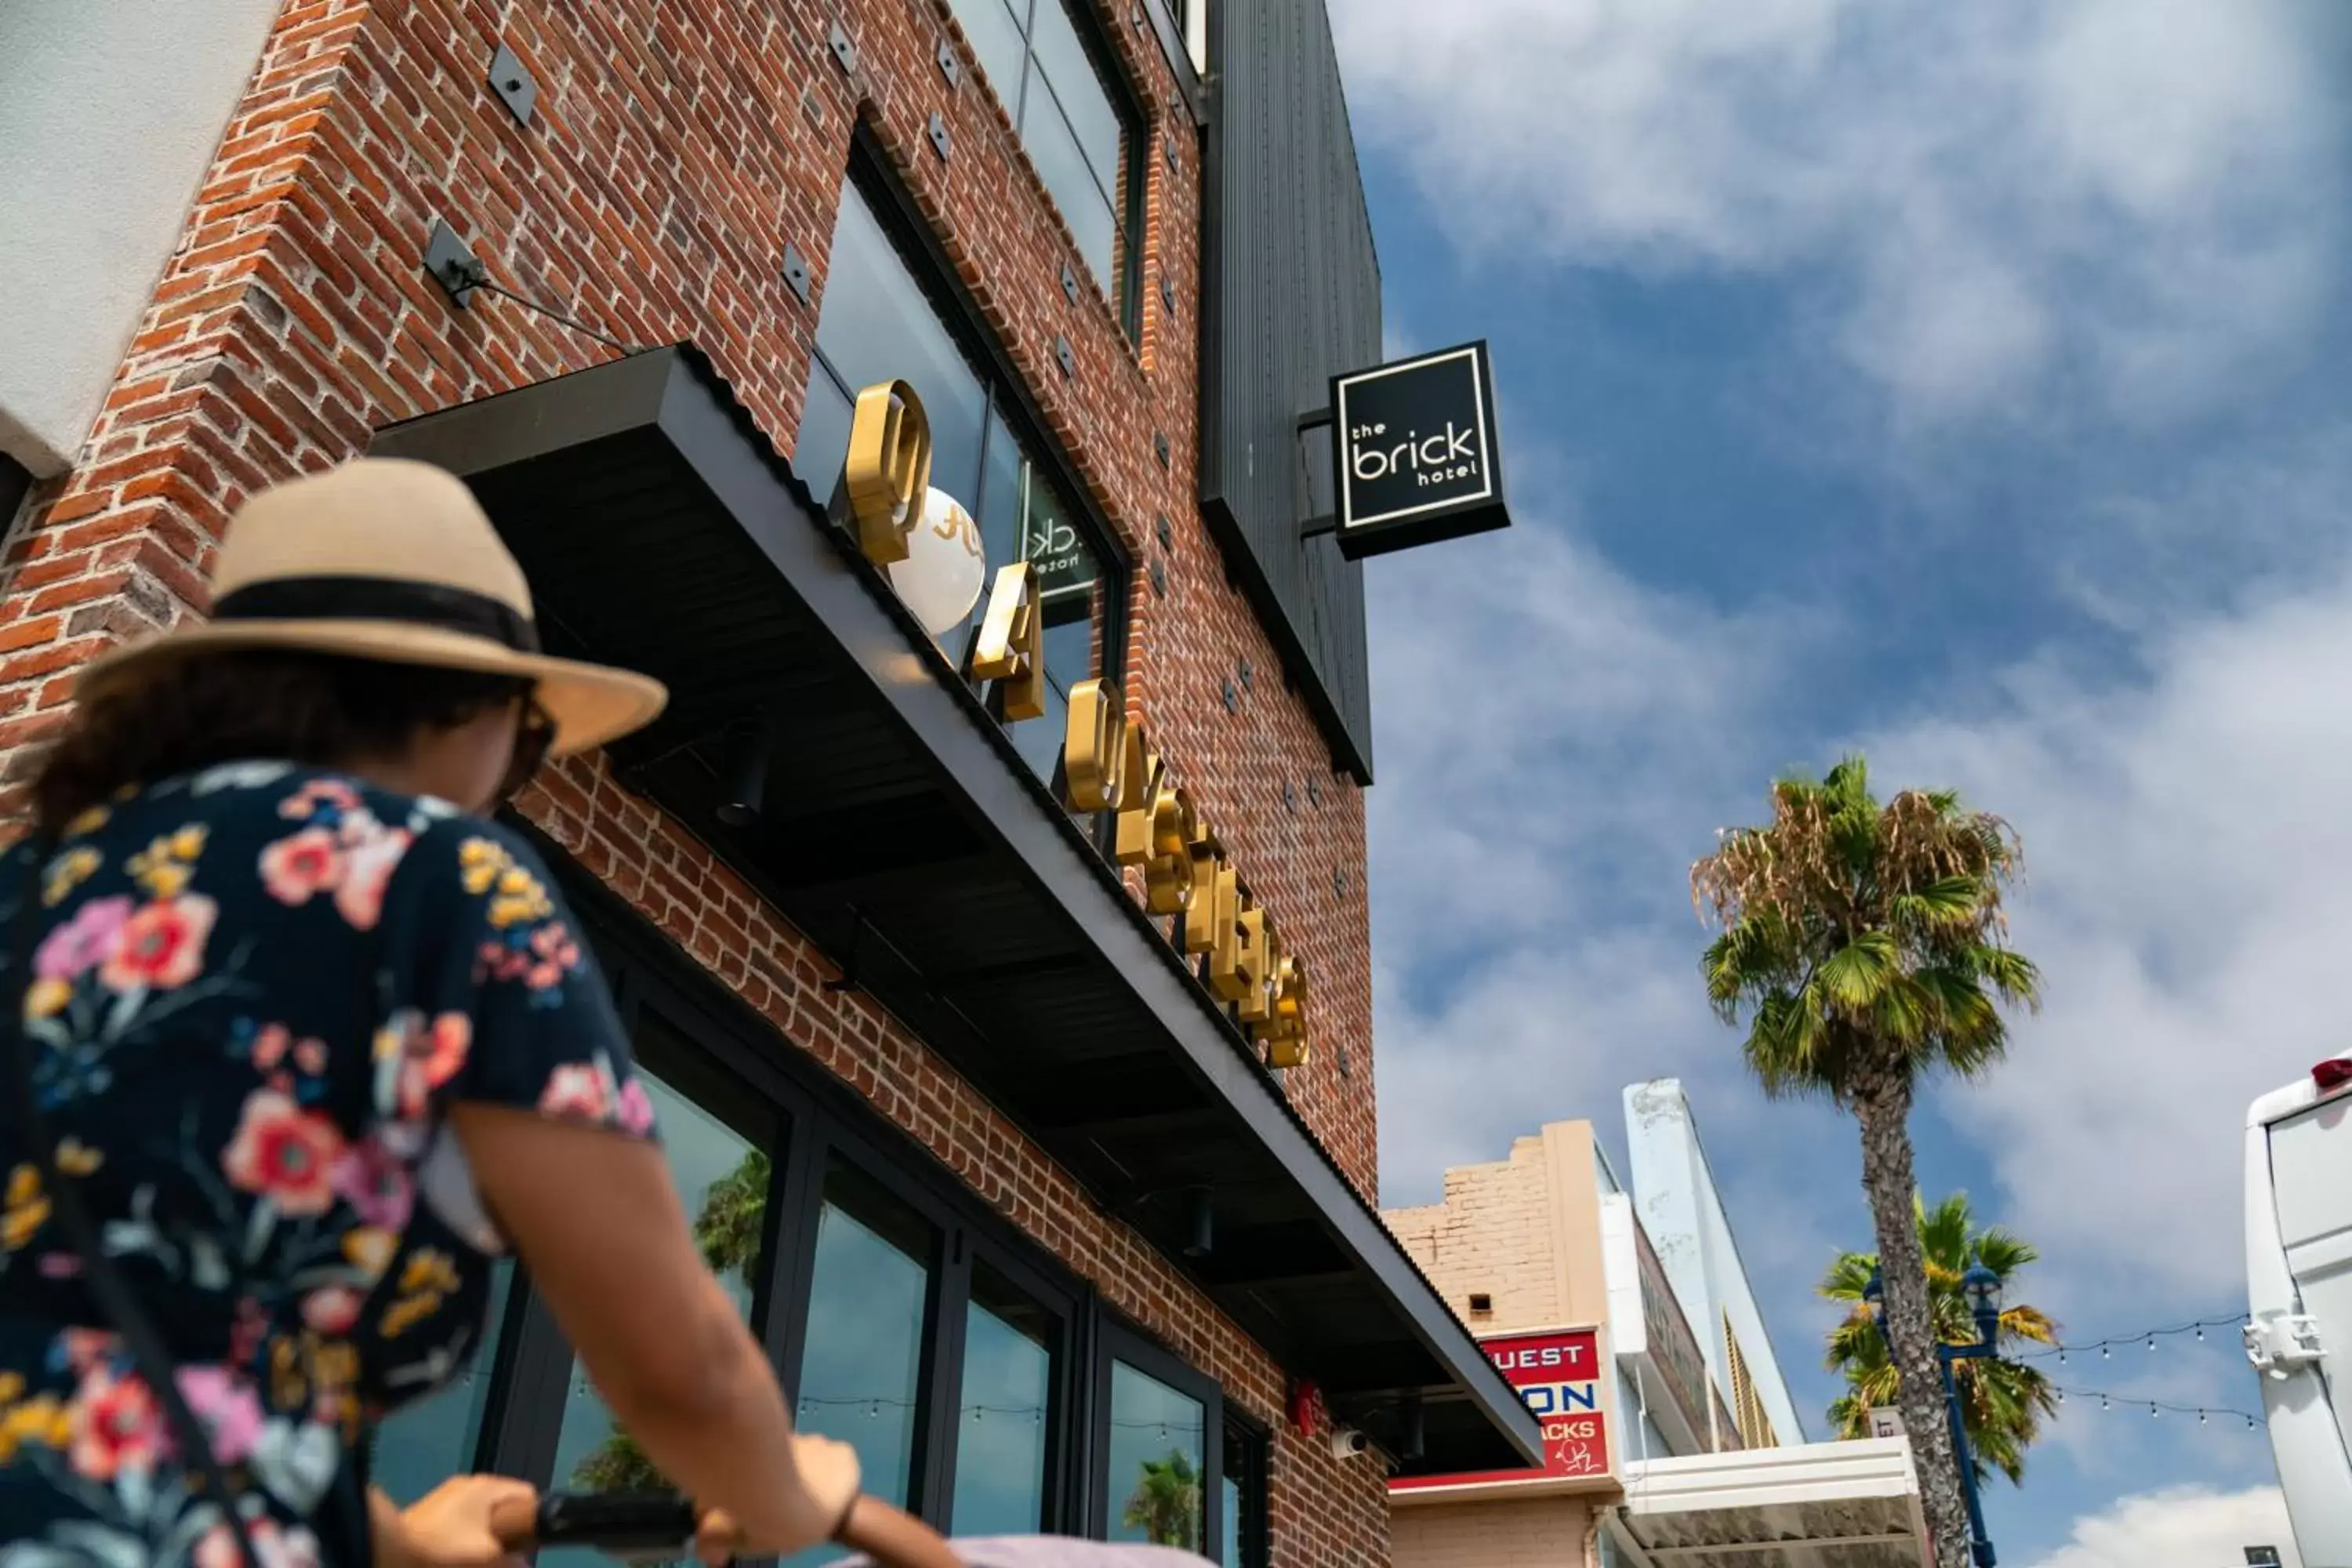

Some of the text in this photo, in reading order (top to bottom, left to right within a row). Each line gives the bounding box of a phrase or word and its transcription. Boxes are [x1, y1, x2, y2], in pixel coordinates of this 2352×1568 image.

[1352, 423, 1386, 440] the
[1352, 421, 1475, 480] brick
[1417, 460, 1478, 486] hotel
